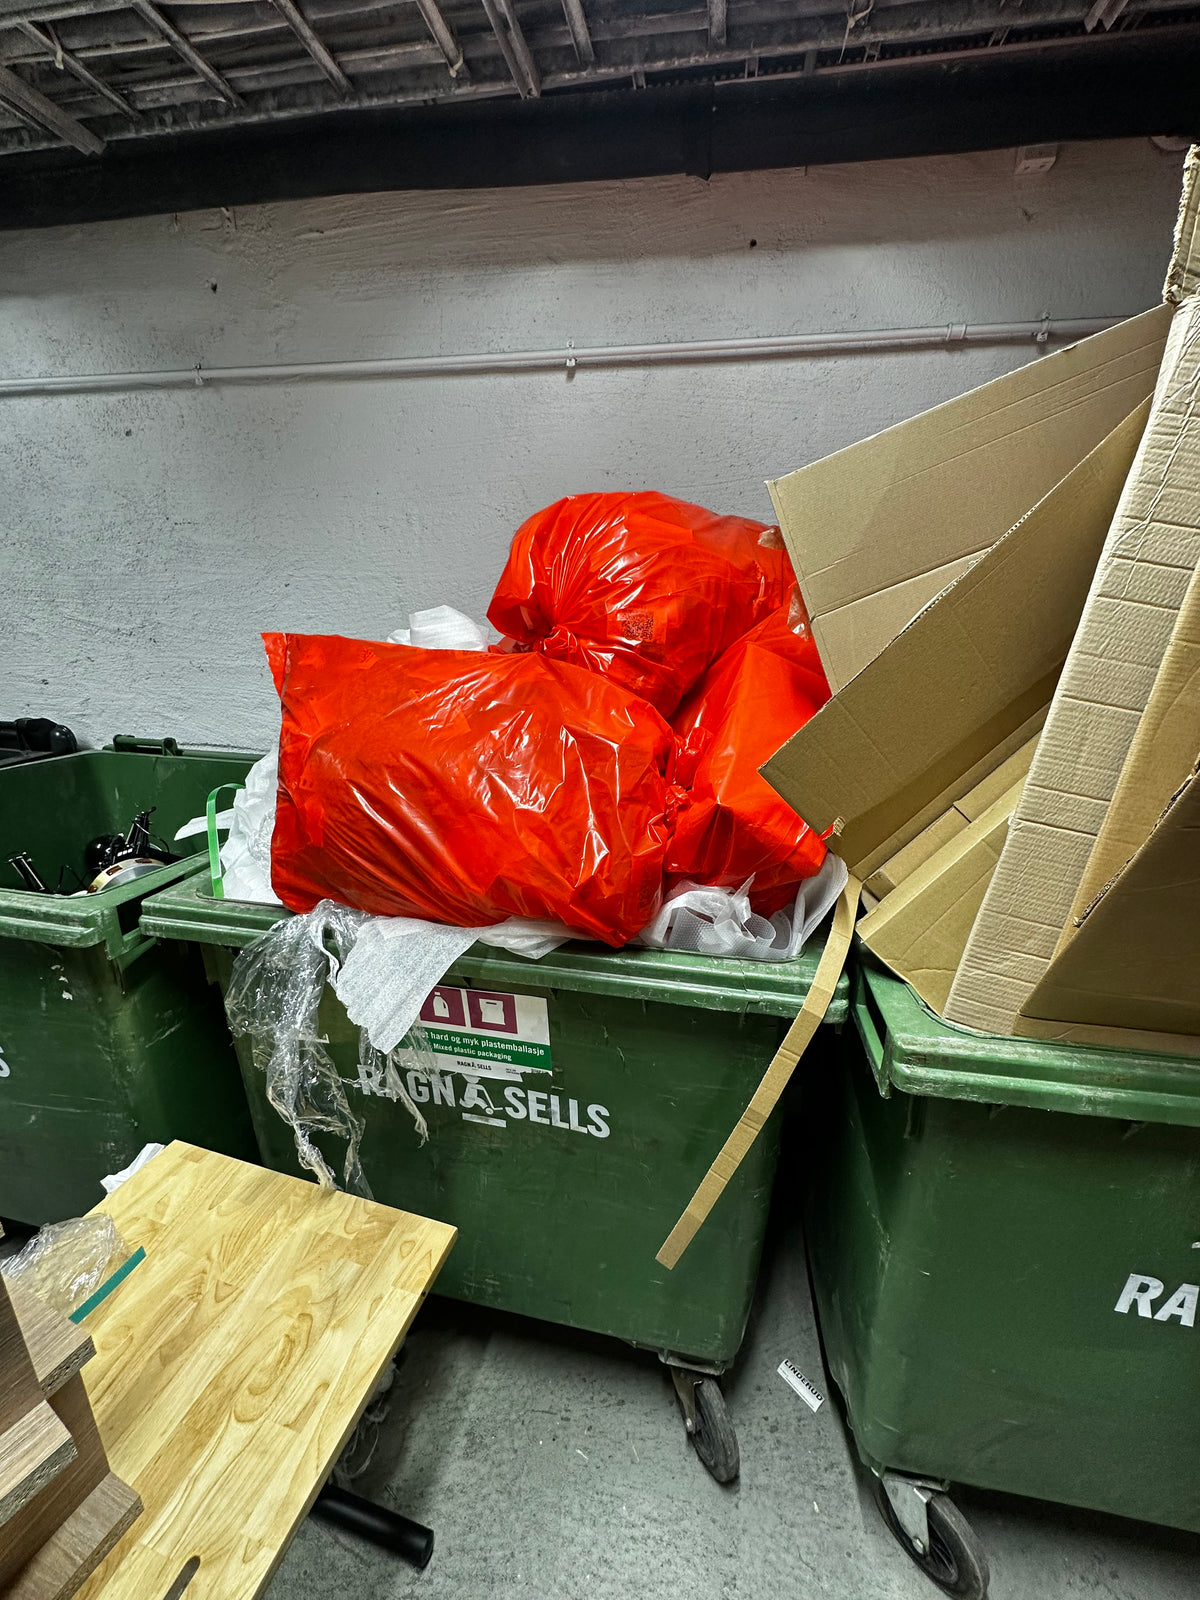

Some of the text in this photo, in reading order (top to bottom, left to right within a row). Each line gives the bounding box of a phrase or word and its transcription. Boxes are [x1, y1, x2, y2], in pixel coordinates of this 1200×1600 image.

[430, 1030, 449, 1042] hard
[450, 1034, 461, 1044] og
[462, 1036, 479, 1046] myk
[481, 1039, 545, 1056] plastemballasje
[433, 1043, 512, 1062] Mixed plastic packaging
[503, 1086, 611, 1138] SELLS
[1114, 1273, 1200, 1328] RA
